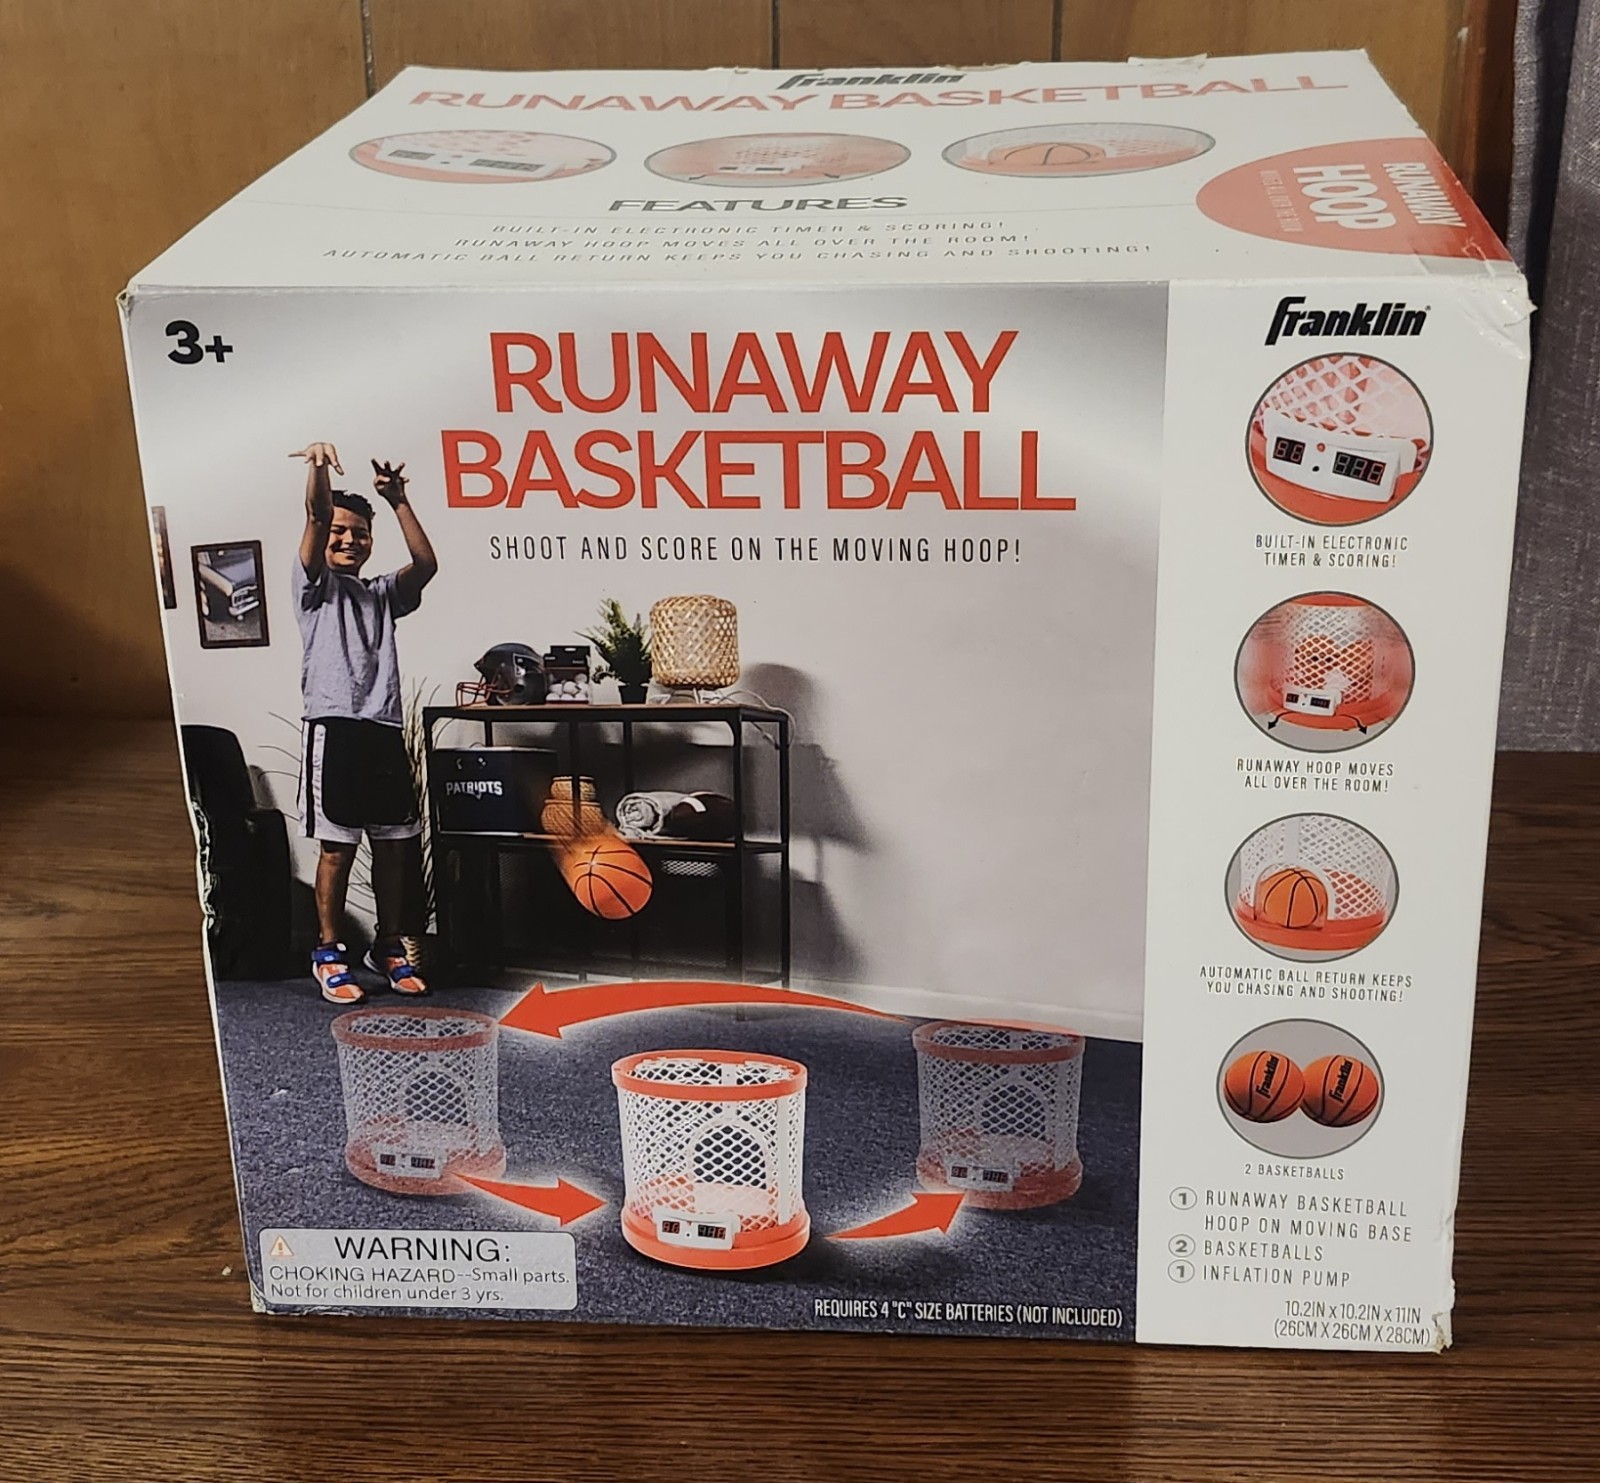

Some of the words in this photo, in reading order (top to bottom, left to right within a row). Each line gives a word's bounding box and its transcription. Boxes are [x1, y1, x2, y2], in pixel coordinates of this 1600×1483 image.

[409, 91, 819, 112] RUNAWAY
[829, 76, 1349, 109] BASKETBALL
[608, 196, 908, 212] FEATURES
[1293, 164, 1396, 229] HOOP
[1382, 162, 1466, 228] RUNAWAY
[492, 225, 598, 234] BUILT-IN
[610, 226, 759, 234] ELECTRONIC
[771, 225, 844, 233] TIMER
[857, 224, 871, 232] &
[885, 221, 1004, 231] SCORING!
[322, 249, 468, 261] AUTOMATIC
[480, 253, 538, 262] BALL
[553, 253, 652, 262] RETURN
[664, 252, 741, 261] KEEPS
[755, 251, 802, 260] YOU
[817, 250, 929, 259] CHASING
[943, 249, 993, 257] AND
[1008, 244, 1150, 256] SHOOTING!
[454, 239, 573, 248] RUNAWAY
[584, 240, 651, 248] HOOP
[662, 239, 746, 248] MOVES
[757, 239, 799, 247] ALL
[814, 237, 877, 246] OVER
[891, 237, 933, 245] THE
[947, 235, 1028, 243] ROOM!
[165, 320, 234, 365] 3+
[489, 330, 1019, 414] RUNAWAY
[440, 430, 1077, 511] BASKETBALL
[490, 535, 567, 561] SHOOT
[581, 536, 628, 561] AND
[641, 537, 718, 562] SCORE
[731, 537, 762, 562] ON
[775, 537, 819, 562] THE
[833, 537, 930, 563] MOVING
[944, 538, 1021, 563] HOOP!
[1255, 534, 1315, 549] BUILT-IN
[1322, 535, 1408, 551] ELECTRONIC
[1264, 552, 1306, 567] TIMER
[1313, 553, 1322, 567] &
[1329, 553, 1397, 568] SCORING!
[1237, 758, 1300, 773] RUNAWAY
[1306, 760, 1342, 775] HOOP
[1348, 762, 1394, 777] MOVES
[446, 780, 503, 798] PATRIOTS
[1244, 775, 1268, 789] ALL
[1274, 776, 1307, 790] OVER
[1314, 777, 1338, 791] THE
[1345, 778, 1389, 793] ROOM!
[1200, 966, 1273, 981] AUTOMATIC
[1279, 969, 1309, 983] BALL
[1316, 971, 1365, 986] RETURN
[1372, 973, 1413, 988] KEEPS
[1207, 981, 1231, 994] YOU
[1237, 982, 1294, 998] CHASING
[1300, 985, 1325, 999] AND
[1332, 986, 1404, 1003] SHOOTING!
[1245, 1163, 1252, 1176] 2
[1258, 1164, 1345, 1181] BASKETBALLS
[1205, 1189, 1288, 1209] RUNAWAY
[1297, 1194, 1408, 1218] BASKETBALL
[1204, 1215, 1250, 1233] HOOP
[1259, 1217, 1280, 1234] ON
[1290, 1219, 1359, 1240] MOVING
[1368, 1223, 1413, 1243] BASE
[334, 1236, 511, 1263] WARNING:
[1204, 1239, 1324, 1262] BASKETBALLS
[269, 1265, 365, 1282] CHOKING
[523, 1269, 570, 1286] parts.
[1203, 1265, 1293, 1285] INFLATION
[1302, 1269, 1351, 1288] PUMP
[271, 1282, 301, 1299] Not
[306, 1283, 328, 1299] for
[333, 1283, 401, 1300] children
[407, 1285, 457, 1301] under
[462, 1287, 471, 1301] 3
[475, 1289, 504, 1304] yrs.
[814, 1299, 878, 1319] REQUIRES
[880, 1302, 889, 1319] 4
[891, 1301, 912, 1321] "C"
[914, 1302, 942, 1321] SIZE
[946, 1303, 1014, 1324] BATTERIES
[1016, 1304, 1049, 1325] (NOT
[1052, 1306, 1123, 1329] INCLUDED)
[1285, 1300, 1325, 1318] 10.2IN
[1340, 1303, 1381, 1321] 10.2IN
[1396, 1307, 1421, 1325] 11IN
[1274, 1318, 1318, 1340] (26CM
[1320, 1321, 1330, 1339] X
[1332, 1322, 1371, 1342] 26CM
[1374, 1325, 1383, 1342] X
[1386, 1326, 1431, 1346] 28CM)
